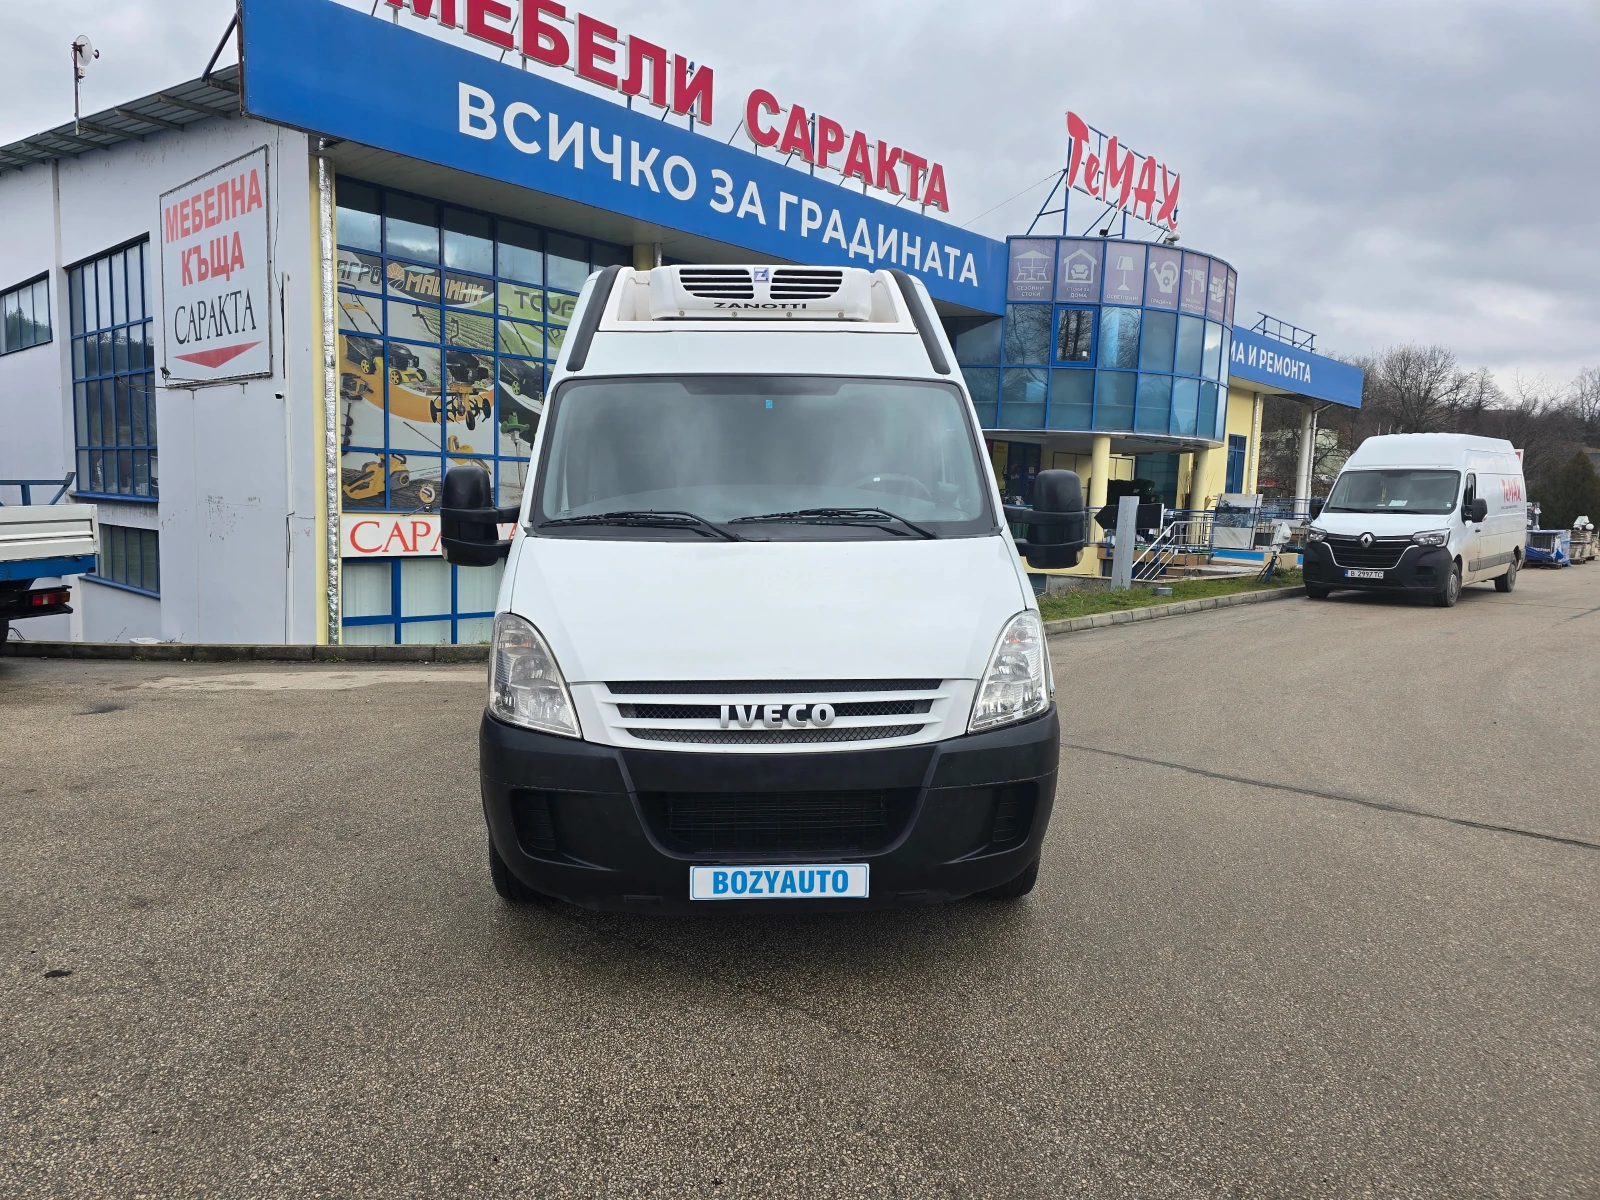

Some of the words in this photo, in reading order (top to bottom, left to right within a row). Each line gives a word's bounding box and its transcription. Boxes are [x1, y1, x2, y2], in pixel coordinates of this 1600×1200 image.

[744, 88, 950, 214] САРАКТА
[164, 168, 264, 245] МЕБЕЛНА
[457, 81, 699, 201] ВСИЧКО
[709, 168, 768, 229] ЗА
[778, 191, 980, 288] ГРАДИНАТА
[181, 230, 245, 286] КЪЩА
[337, 260, 383, 286] АГРО
[405, 271, 485, 304] МАШИНИ
[173, 288, 257, 346] САРАКТА
[1150, 297, 1172, 306] ГРАДИНА
[1248, 344, 1258, 367] И
[1259, 348, 1311, 384] РЕМОНТА
[719, 703, 835, 729] IVECO
[712, 870, 849, 895] BOZYAUTO
